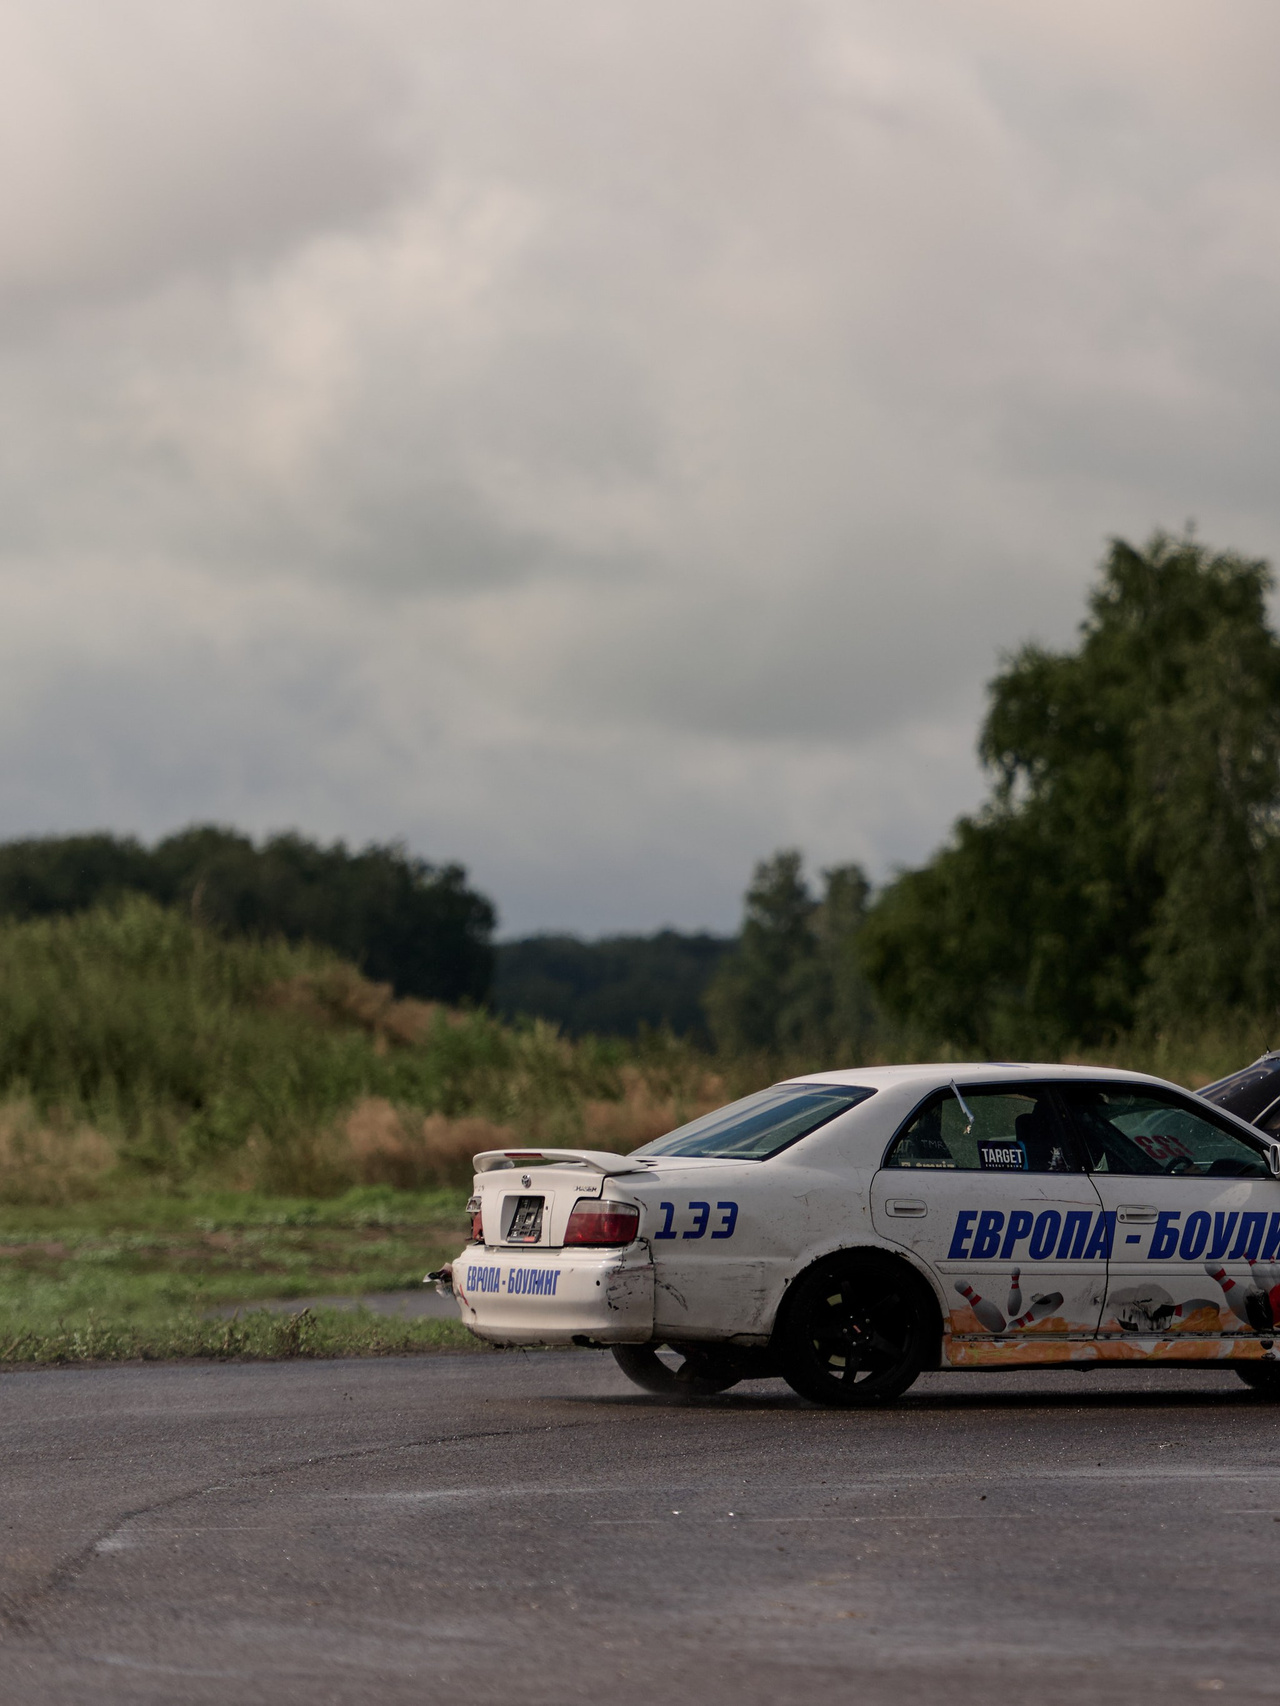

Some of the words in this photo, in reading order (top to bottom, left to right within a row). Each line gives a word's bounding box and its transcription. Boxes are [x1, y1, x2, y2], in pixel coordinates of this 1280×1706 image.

[981, 1148, 1023, 1164] TARGET
[654, 1202, 739, 1239] 133
[948, 1210, 1117, 1260] ЕВРОПА
[467, 1265, 501, 1293] ЕВРОПА
[507, 1267, 561, 1296] БОУЛИНГ
